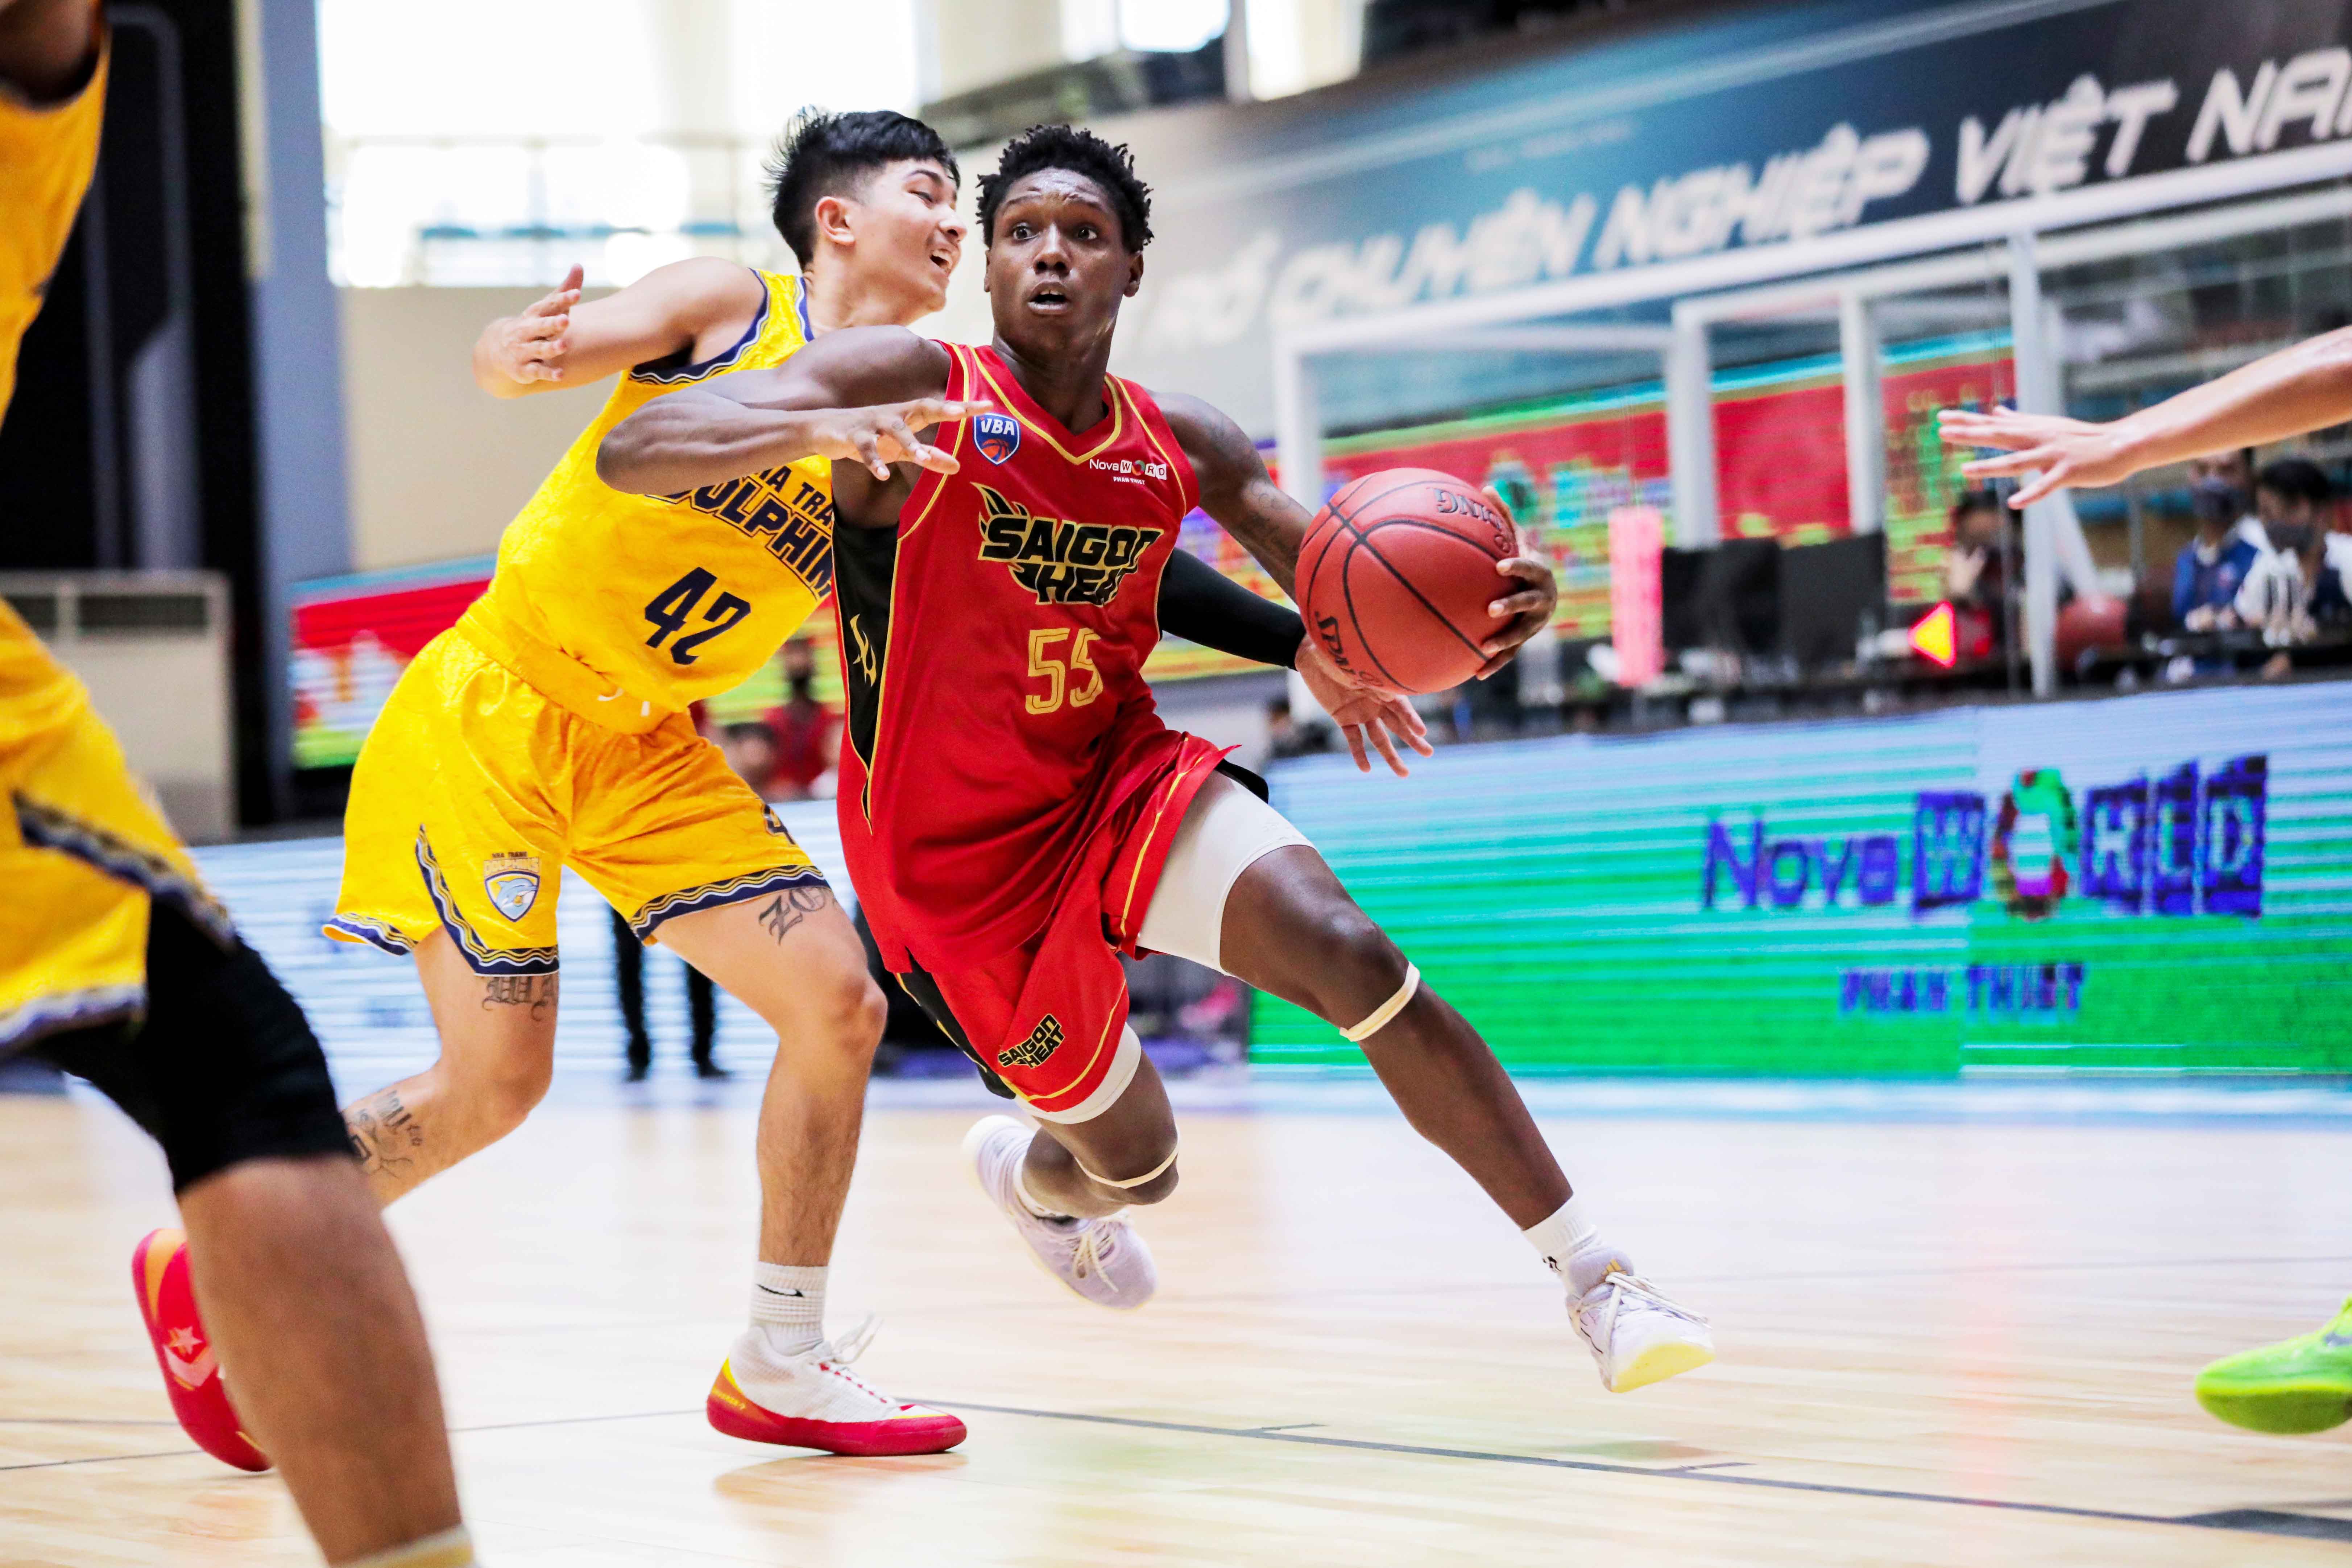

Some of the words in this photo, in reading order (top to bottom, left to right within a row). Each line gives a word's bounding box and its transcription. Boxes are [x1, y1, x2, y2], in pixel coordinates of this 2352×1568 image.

[981, 418, 1015, 436] VBA
[792, 481, 833, 529] TRA
[653, 476, 833, 600] OLPHIN
[645, 566, 751, 665] 42
[1025, 628, 1104, 715] 55
[998, 1014, 1061, 1067] SAIGON
[1019, 1025, 1065, 1069] HEAT
